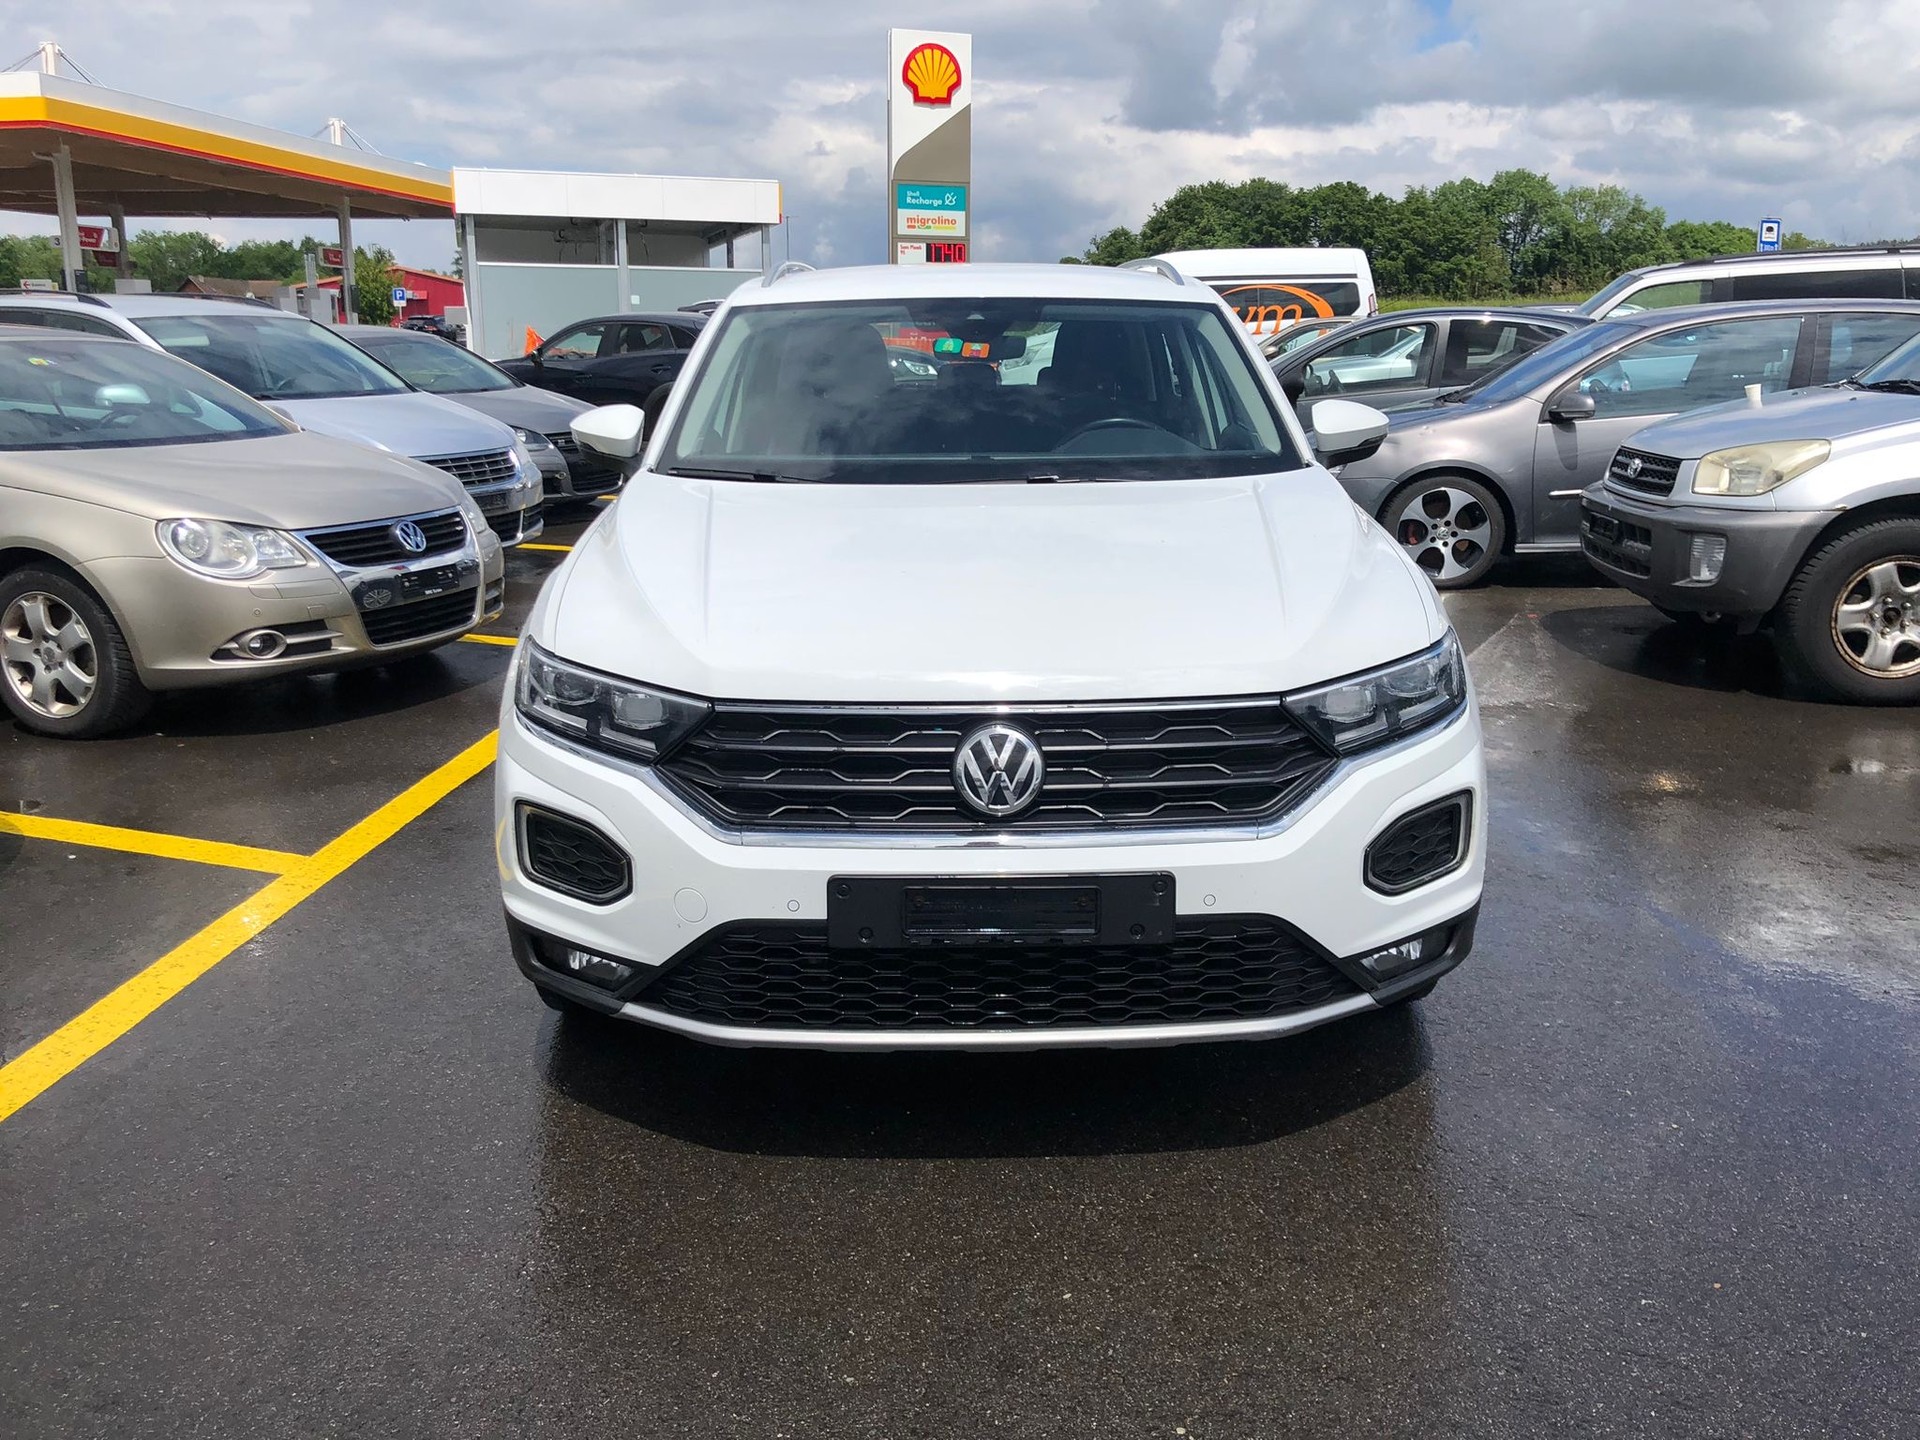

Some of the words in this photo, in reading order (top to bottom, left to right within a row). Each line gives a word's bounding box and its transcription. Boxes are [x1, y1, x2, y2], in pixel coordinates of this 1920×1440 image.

[906, 196, 943, 207] Recharge
[906, 214, 957, 227] migrolino
[395, 290, 403, 300] P
